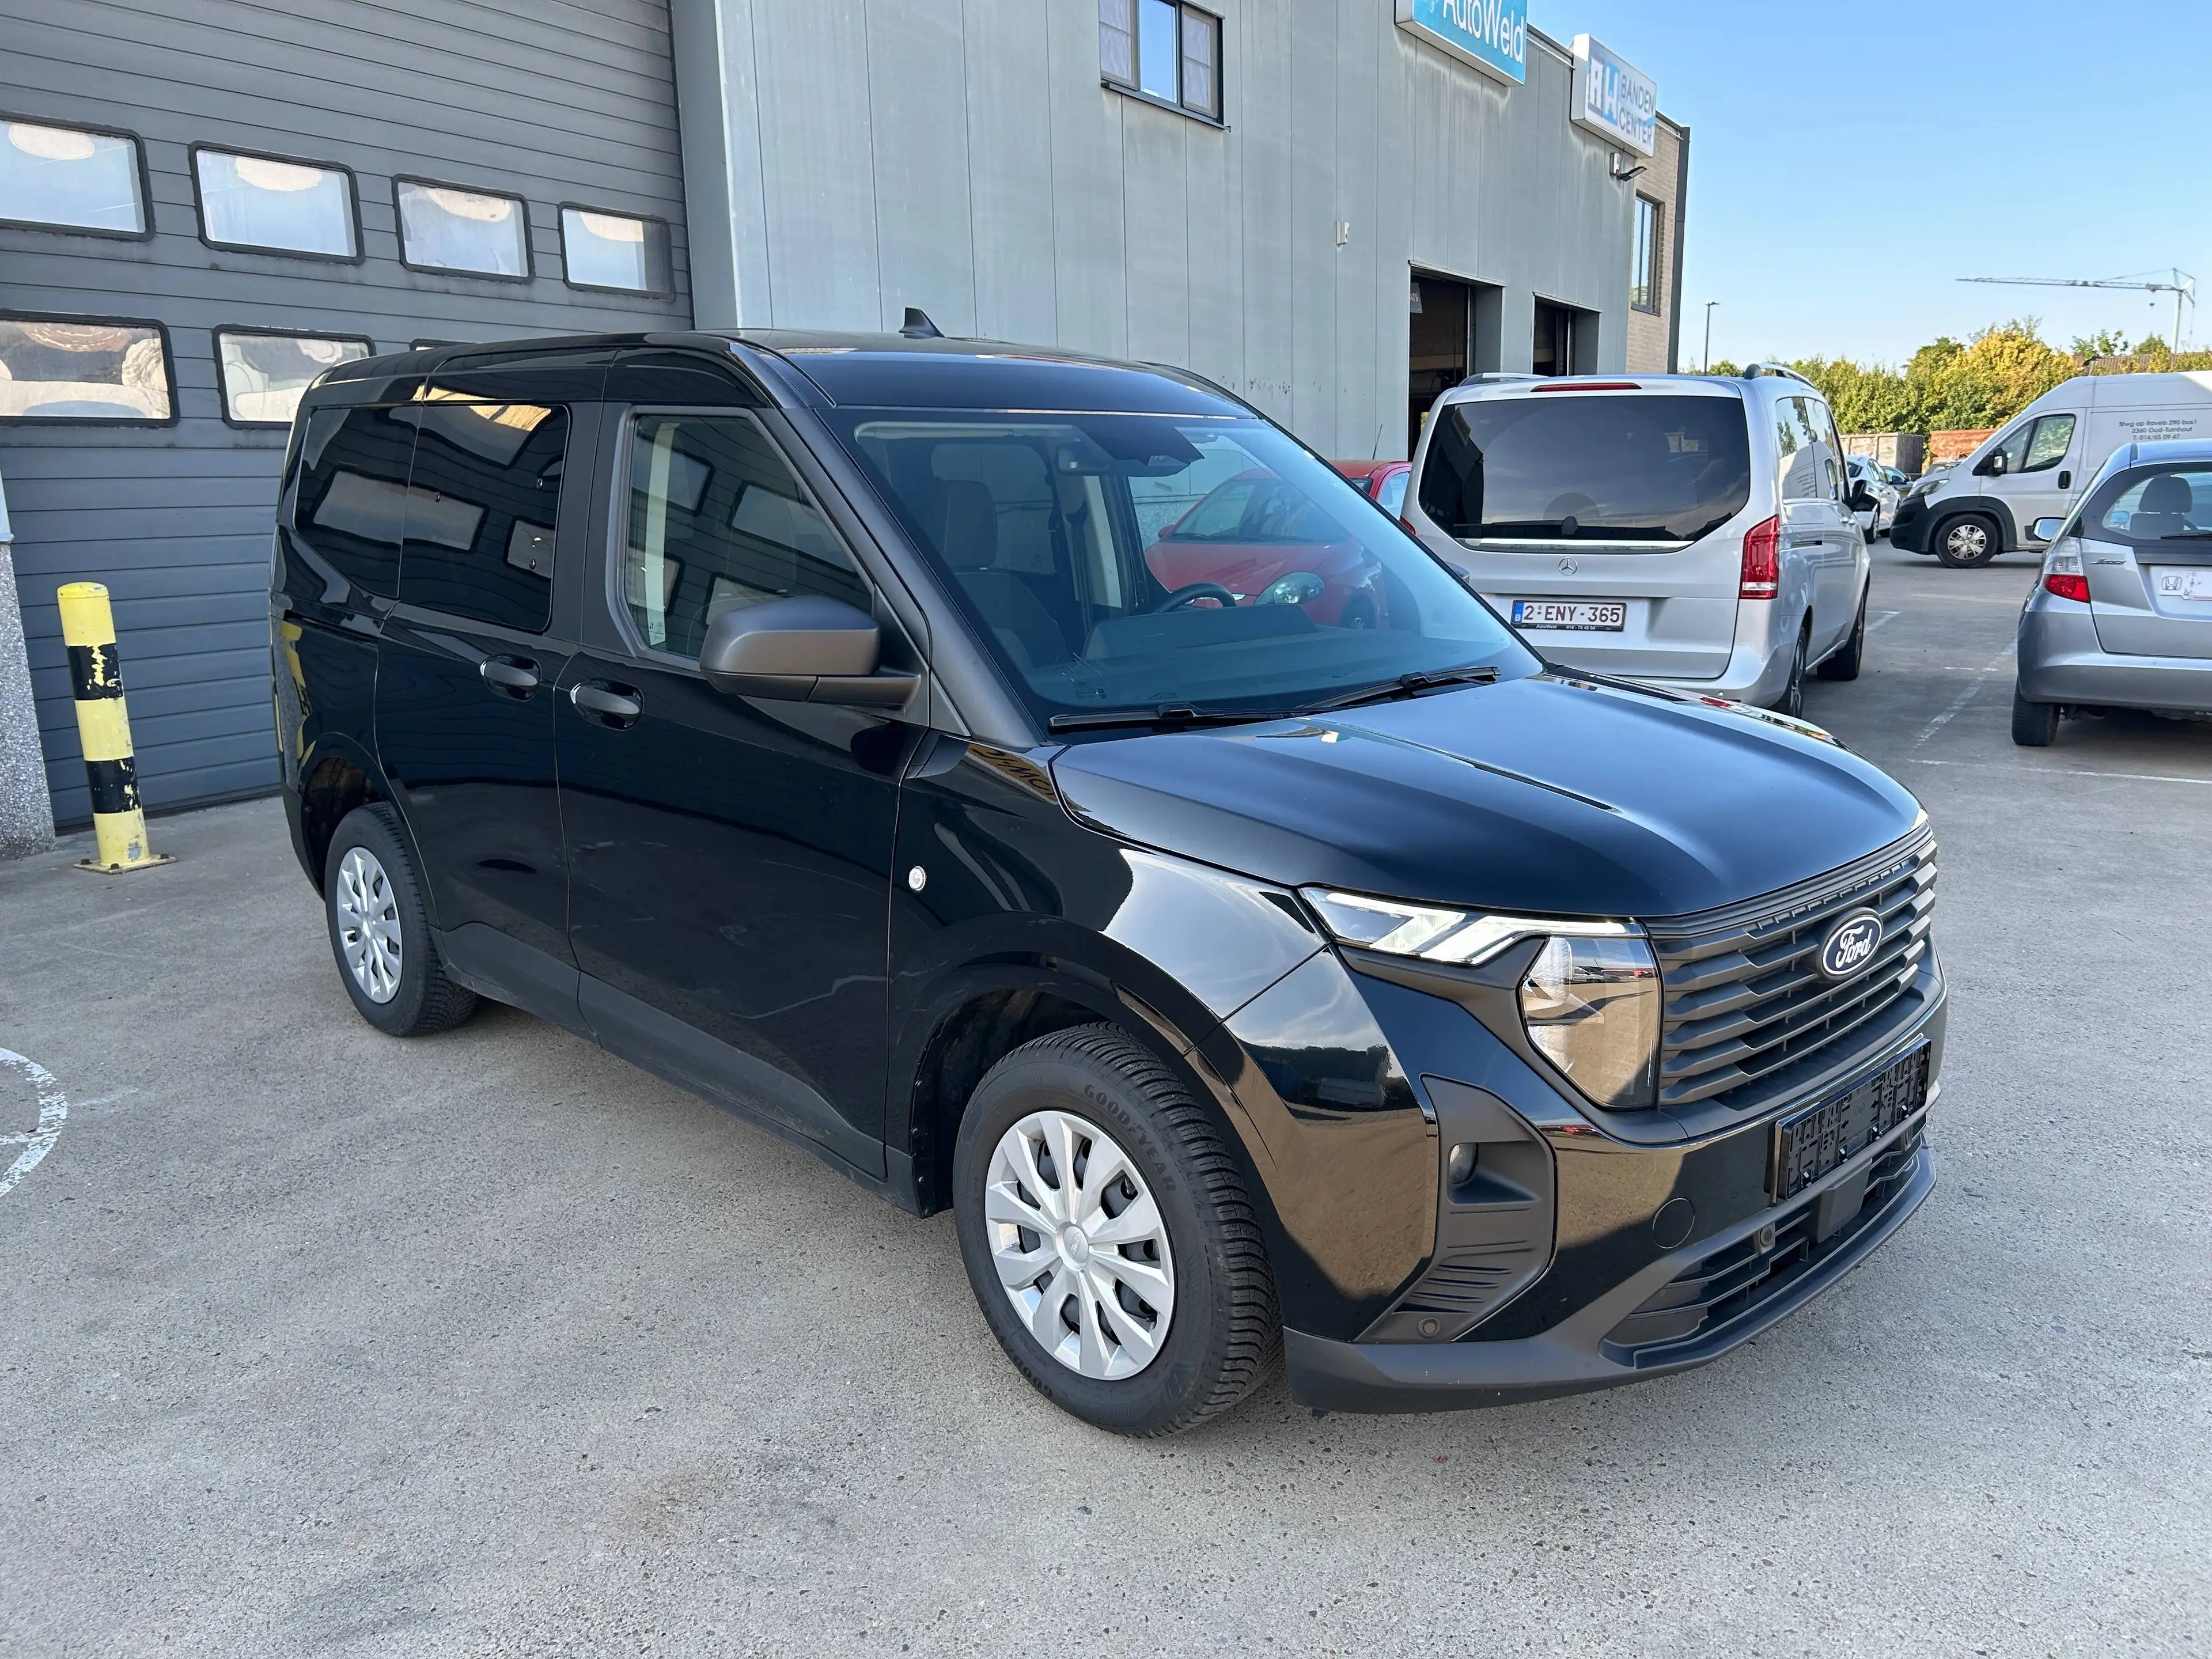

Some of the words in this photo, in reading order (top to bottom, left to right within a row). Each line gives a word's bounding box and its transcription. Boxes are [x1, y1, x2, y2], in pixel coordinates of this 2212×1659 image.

[1620, 74, 1654, 115] BANDEN
[1618, 107, 1653, 147] CENTER
[1514, 613, 1521, 622] B
[1835, 925, 1873, 968] Ford
[1084, 1084, 1177, 1191] GOODYEAR
